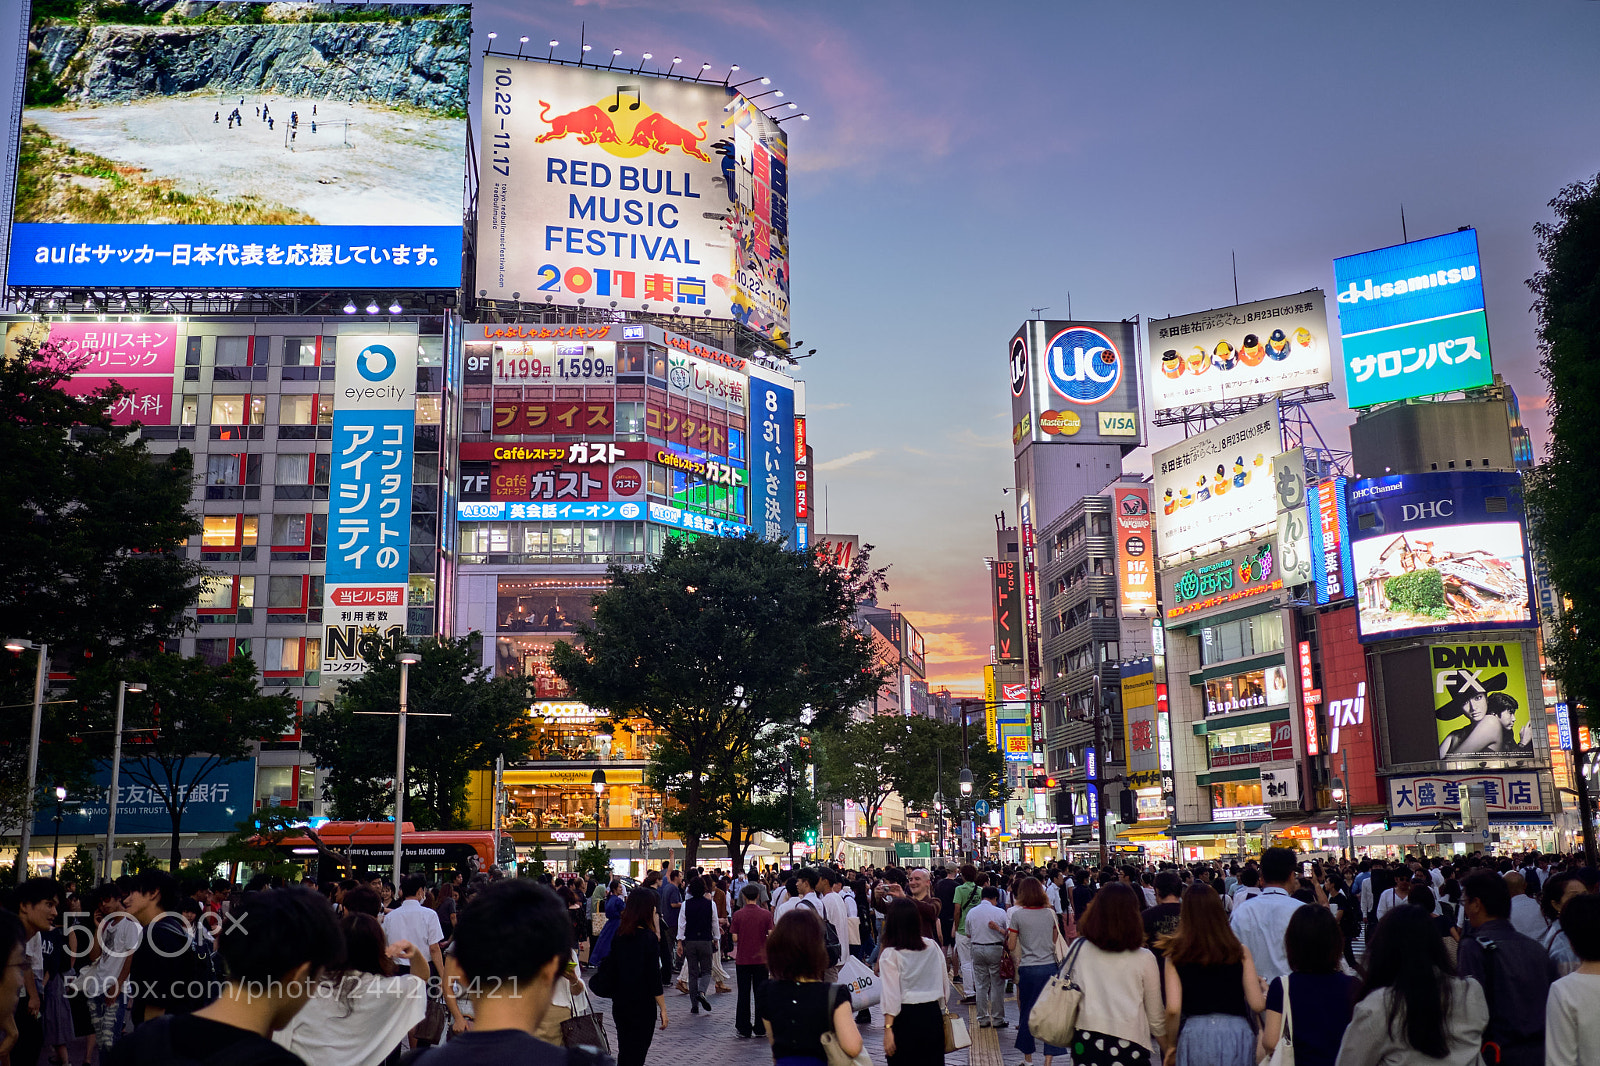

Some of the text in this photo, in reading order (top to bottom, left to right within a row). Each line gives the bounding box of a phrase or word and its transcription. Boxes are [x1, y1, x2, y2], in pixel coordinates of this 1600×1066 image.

[546, 157, 700, 199] RED BULL
[569, 193, 679, 229] MUSIC
[545, 225, 700, 265] FESTIVAL
[34, 243, 439, 268] auはサッカー日本代表を応援しています。
[536, 264, 636, 299] 2017
[644, 273, 706, 305] 東京
[1337, 265, 1476, 304] Hisamitsu
[82, 332, 168, 349] 品川スキン
[484, 325, 611, 339] しゃぶしゃぶバイキング
[80, 350, 158, 367] クリニック
[467, 356, 489, 371] 9F
[1053, 346, 1115, 383] UC
[1350, 336, 1481, 383] サロンパス
[496, 358, 551, 381] 1,199円
[557, 358, 614, 381] 1,599円
[345, 385, 405, 402] eyecity
[695, 369, 742, 402] しゃぶ葉
[495, 405, 612, 428] プライス
[1040, 418, 1081, 427] MasterCard
[1103, 418, 1135, 430] VISA
[647, 408, 725, 447] コンタクト
[568, 442, 625, 464] ガスト
[462, 475, 489, 492] 7F
[496, 474, 527, 487] Café
[706, 460, 742, 487] ガスト
[530, 471, 602, 499] ガスト
[616, 480, 639, 489] ガスト
[1353, 481, 1403, 499] DHC Channel
[338, 425, 403, 569] コンタクト アイシティ
[463, 506, 498, 517] AEON
[510, 503, 615, 519] 英会話イーオン
[653, 506, 678, 522] AEON
[1401, 499, 1454, 522] DHC
[1200, 567, 1233, 596] 西村
[340, 590, 399, 603] 当ビル5階
[341, 611, 388, 622] 利用者数
[1432, 625, 1449, 633] DHC
[1432, 645, 1509, 668] DMM
[1436, 669, 1486, 693] FX
[1208, 694, 1264, 713] Euphoria
[1273, 724, 1291, 744] JTB
[1010, 737, 1026, 752] 薬
[139, 806, 163, 814] TRUST
[165, 806, 188, 814] BNK
[405, 848, 417, 856] bus
[418, 848, 446, 856] HACHIKO
